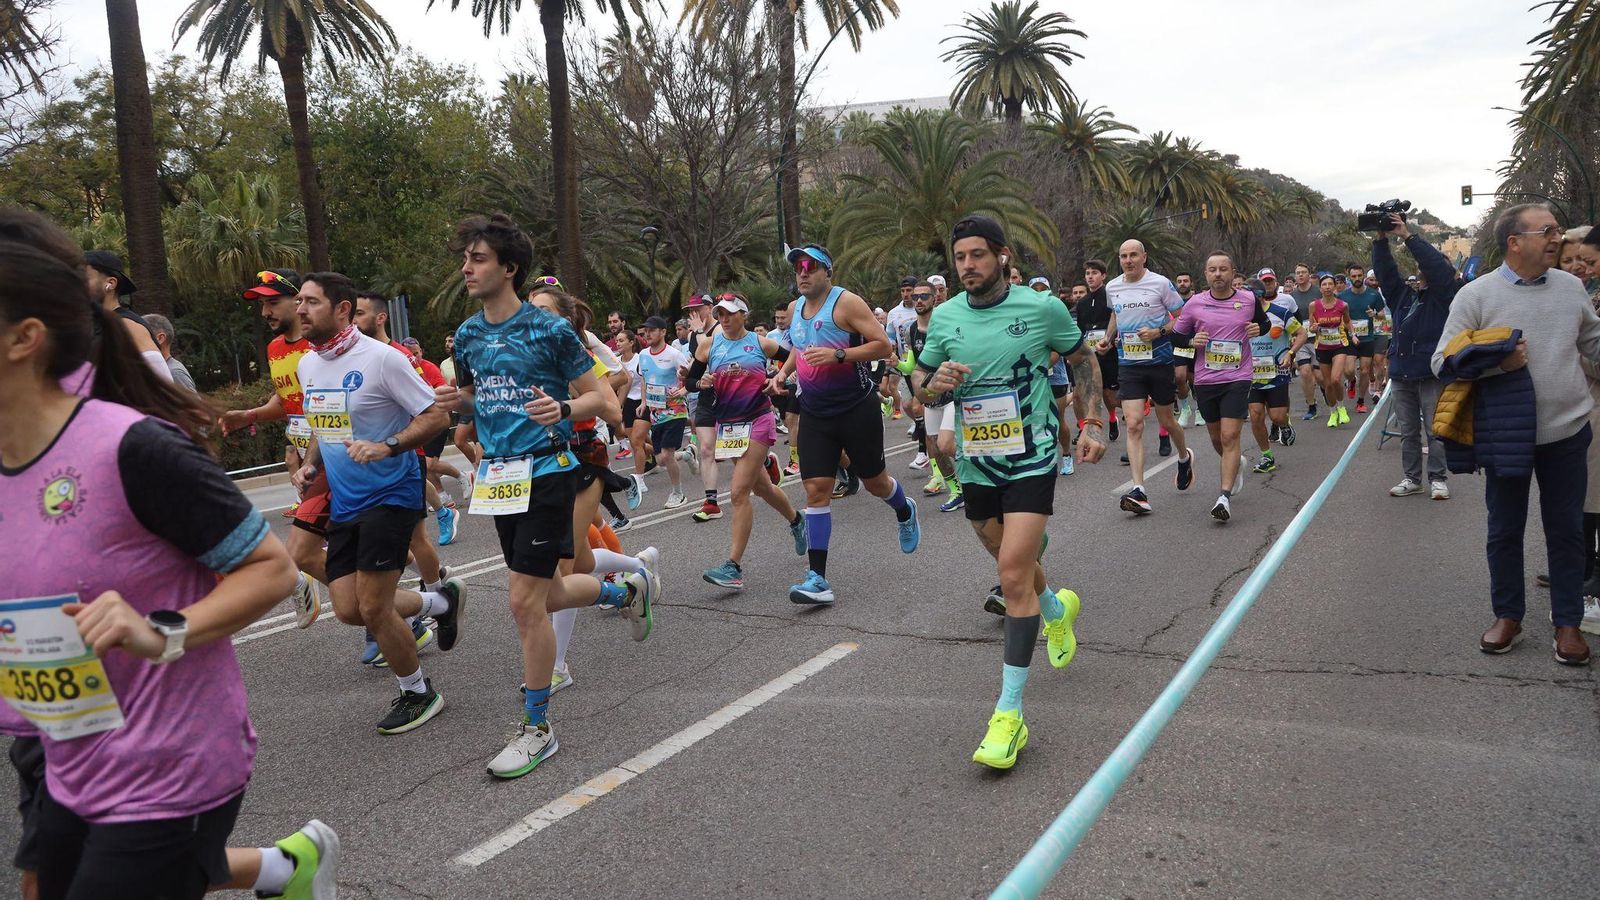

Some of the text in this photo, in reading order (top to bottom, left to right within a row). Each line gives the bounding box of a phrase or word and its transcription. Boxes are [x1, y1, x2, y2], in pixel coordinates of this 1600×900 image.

[1122, 301, 1150, 310] FIDIAS
[1126, 344, 1147, 352] 1773
[1212, 354, 1236, 363] 1789
[480, 375, 517, 388] MEDIA
[313, 415, 342, 429] 1723
[969, 423, 1011, 441] 2350
[722, 439, 743, 449] 3220
[487, 483, 522, 500] 3636
[8, 667, 81, 703] 3568
